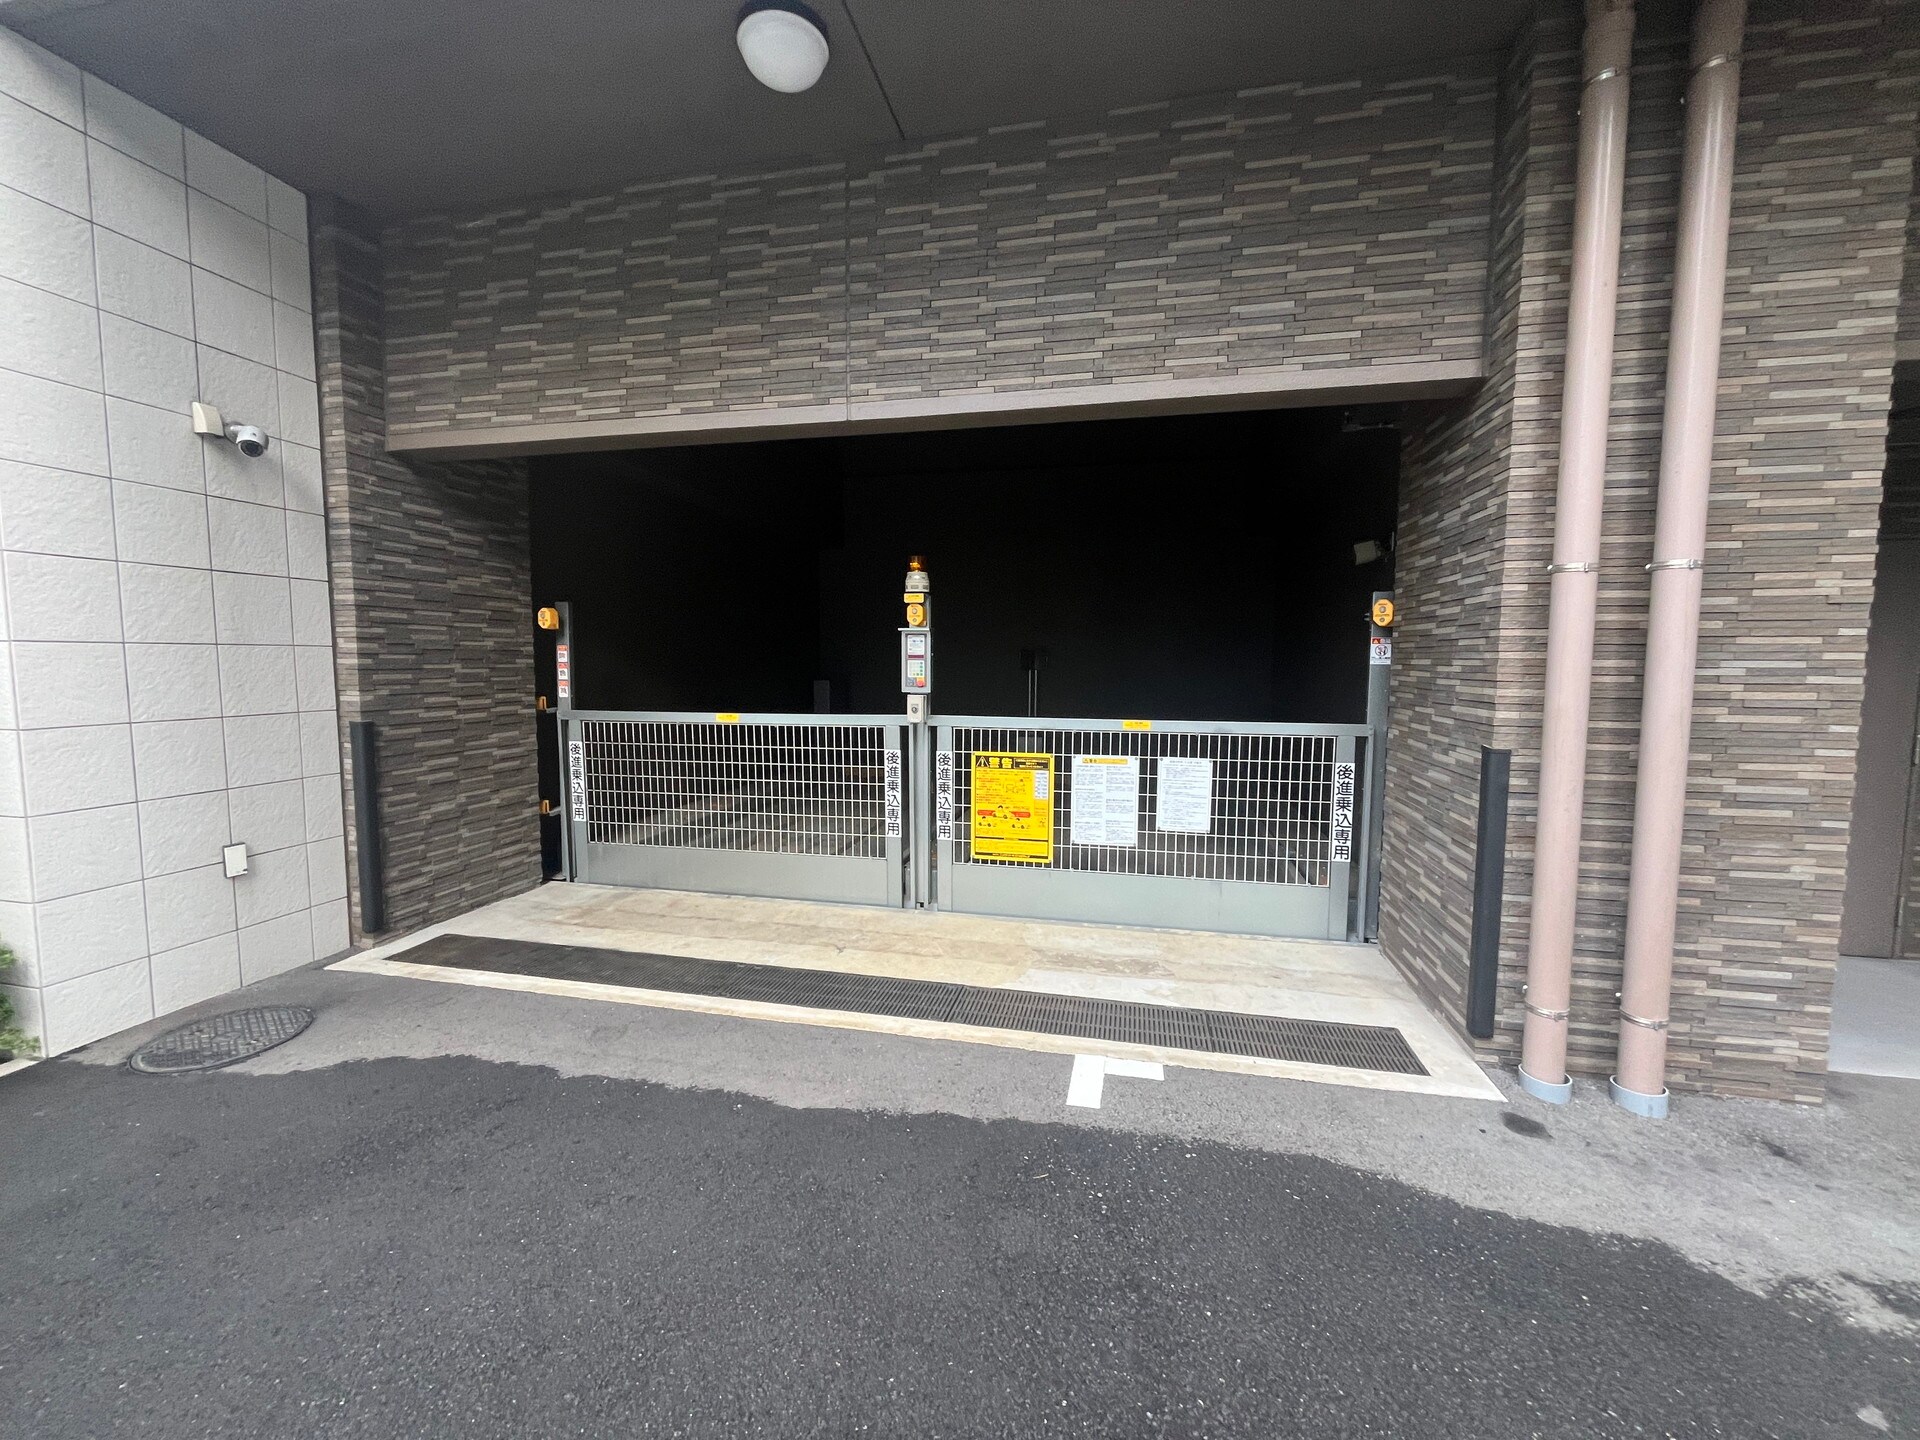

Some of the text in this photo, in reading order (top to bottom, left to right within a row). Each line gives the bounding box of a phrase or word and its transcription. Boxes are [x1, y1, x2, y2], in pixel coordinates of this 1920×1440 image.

[570, 743, 584, 819] 後進乗込専用
[886, 751, 900, 835] 後進乗込専用
[938, 752, 951, 838] 後進乗込専用
[1334, 764, 1354, 860] 後進乗込専用
